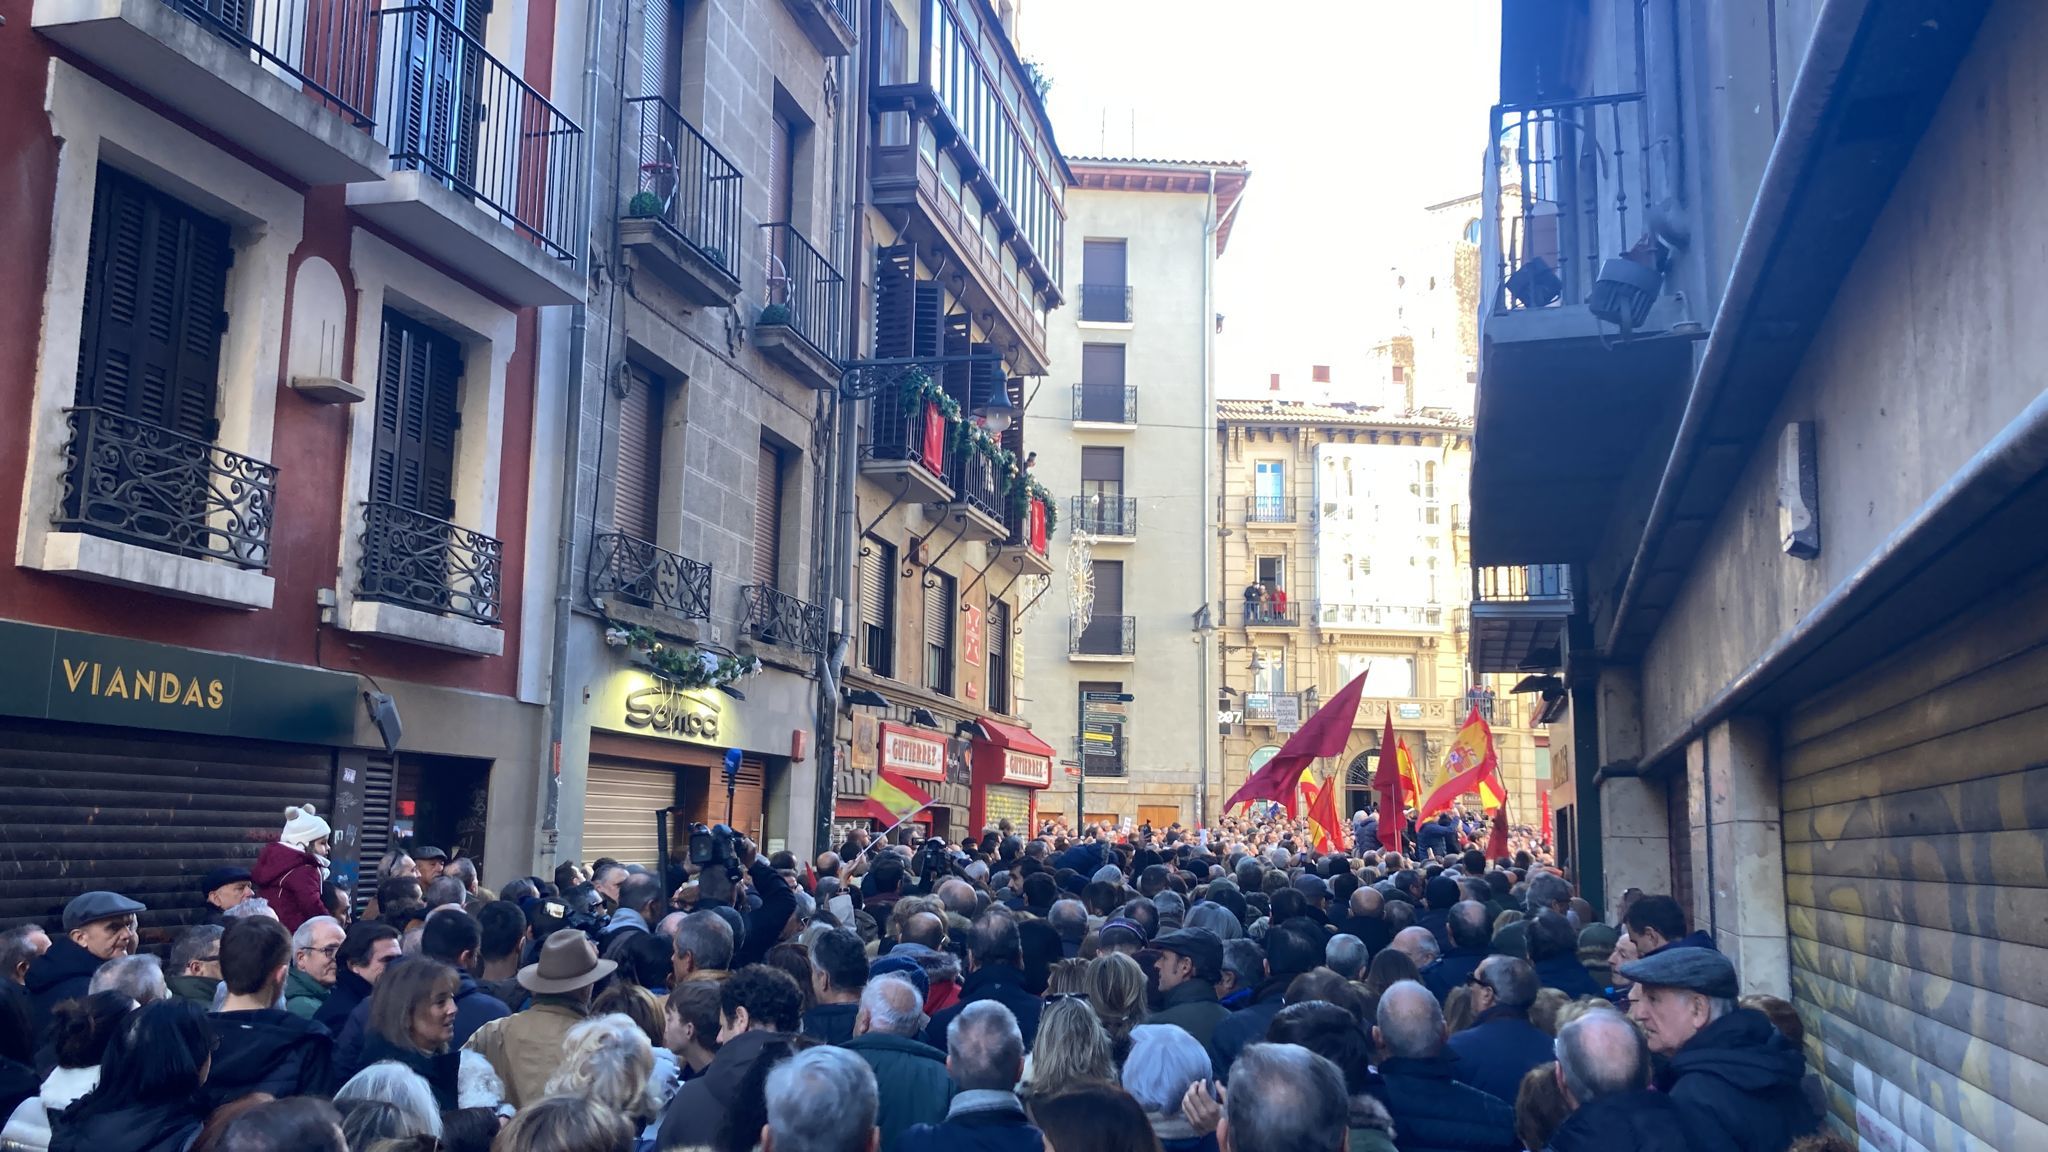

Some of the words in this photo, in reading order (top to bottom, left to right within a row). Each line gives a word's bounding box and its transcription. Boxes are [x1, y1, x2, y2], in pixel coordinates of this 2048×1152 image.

[63, 658, 224, 710] VIANDAS
[892, 738, 937, 766] GUTIERREZ
[1010, 754, 1043, 778] GUTIERREZ
